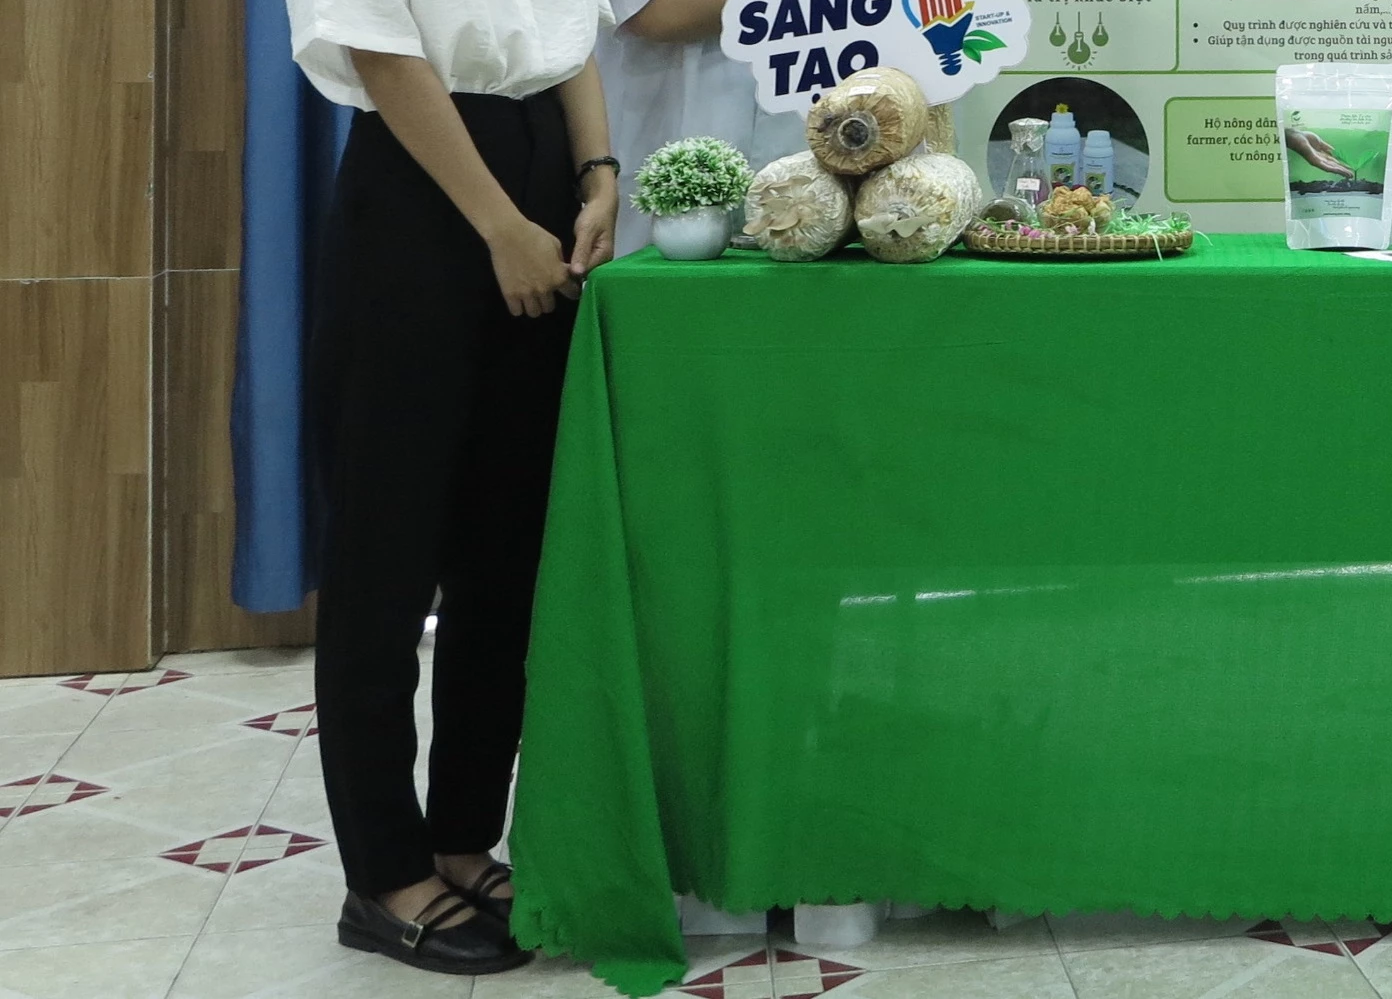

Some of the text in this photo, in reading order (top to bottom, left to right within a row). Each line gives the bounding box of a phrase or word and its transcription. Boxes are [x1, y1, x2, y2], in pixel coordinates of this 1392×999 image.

[1223, 20, 1245, 32] Quy
[1248, 19, 1276, 29] trình
[1279, 19, 1307, 31] được
[1309, 20, 1348, 31] nghiên
[1373, 19, 1386, 29] và
[1208, 34, 1233, 47] Giúp
[1257, 35, 1285, 47] dụng
[1287, 35, 1316, 46] được
[1356, 34, 1371, 44] tài
[1294, 51, 1324, 62] trong
[1327, 50, 1347, 62] quá
[1350, 50, 1378, 60] trình
[769, 39, 879, 104] TẠO
[1204, 117, 1221, 130] Hộ
[1224, 117, 1252, 130] nông
[1187, 134, 1231, 146] farmer,
[1234, 133, 1253, 144] các
[1256, 134, 1271, 146] hộ
[1230, 152, 1245, 161] tư
[1246, 151, 1274, 163] nông
